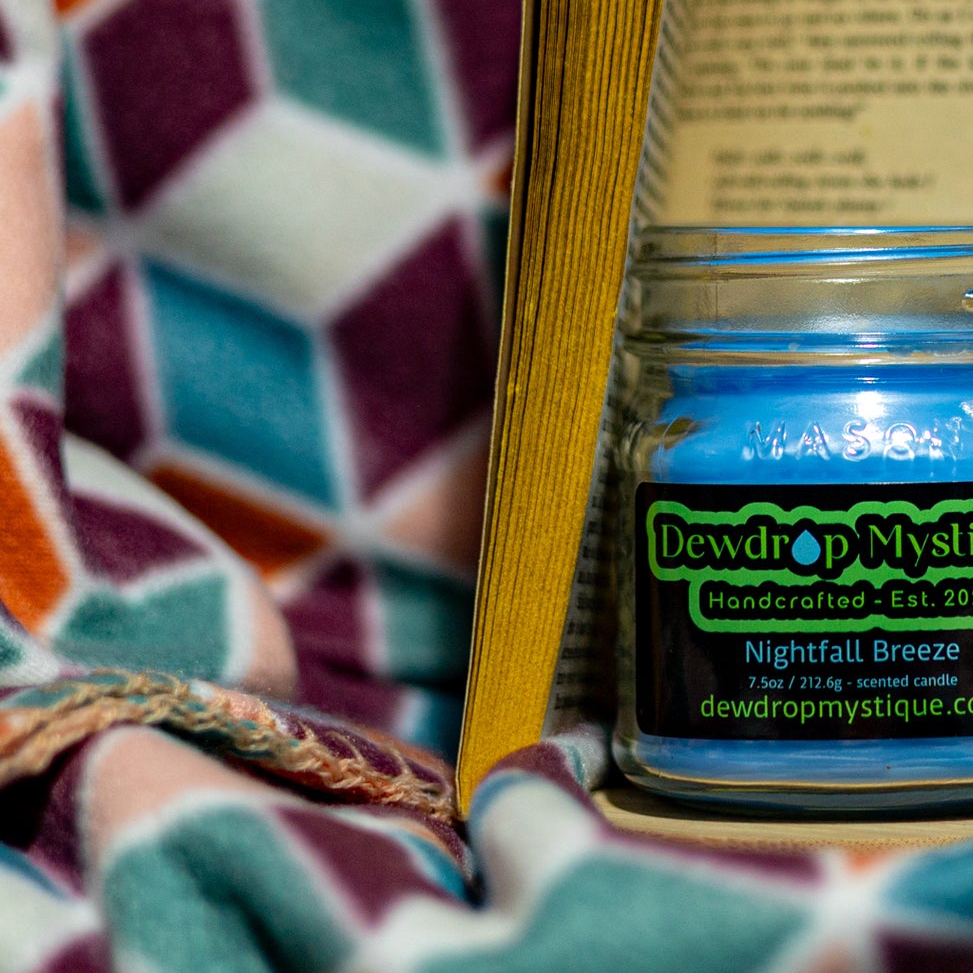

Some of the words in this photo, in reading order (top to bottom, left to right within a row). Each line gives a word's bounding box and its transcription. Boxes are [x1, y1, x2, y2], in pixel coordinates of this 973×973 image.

[660, 523, 849, 569] Dewdrop
[708, 590, 866, 610] Handcrafted
[890, 589, 936, 609] Est.
[745, 639, 864, 669] Nightfall
[873, 639, 961, 662] Breeze
[748, 675, 784, 690] 7.5oz
[788, 675, 796, 690] /
[800, 675, 843, 692] 212.6g
[856, 674, 909, 689] scented
[913, 673, 959, 688] candle
